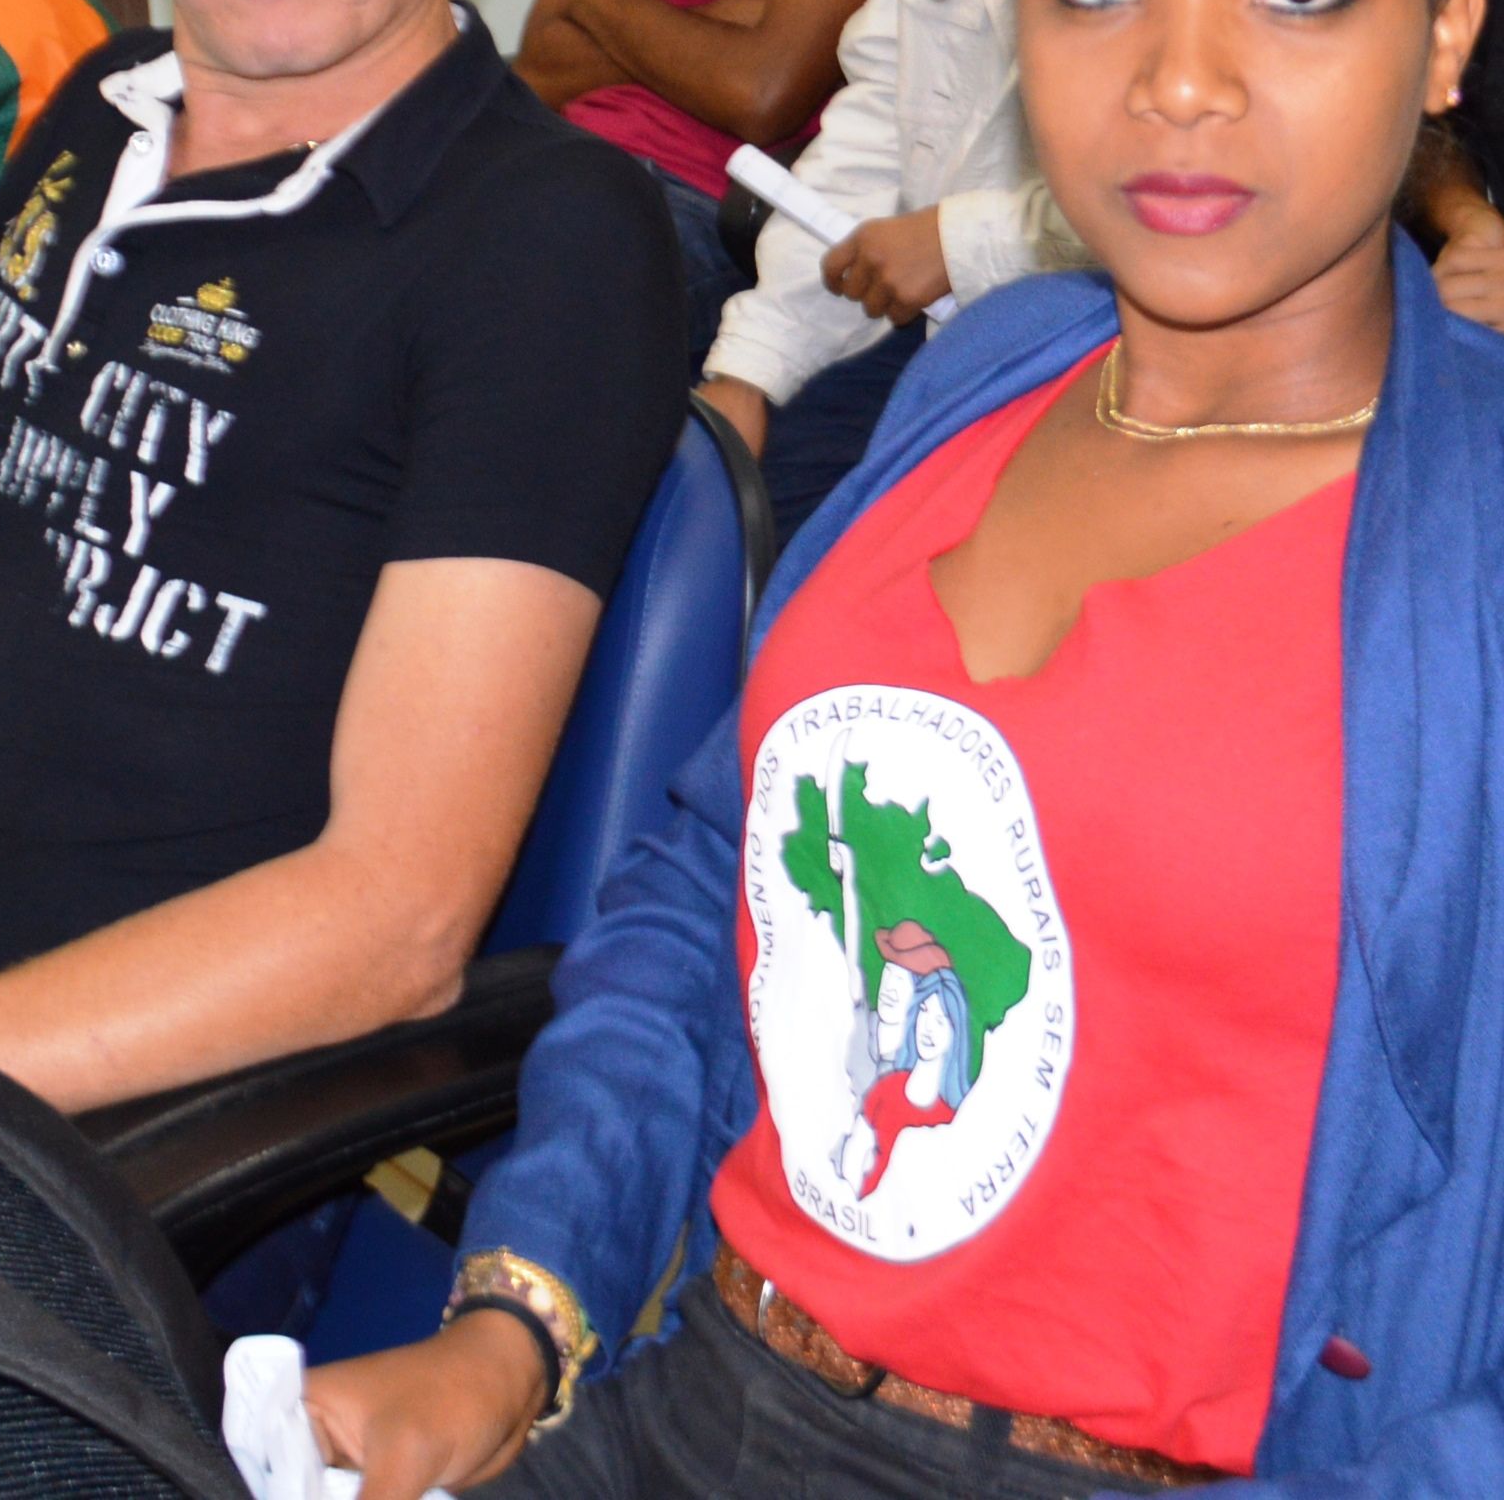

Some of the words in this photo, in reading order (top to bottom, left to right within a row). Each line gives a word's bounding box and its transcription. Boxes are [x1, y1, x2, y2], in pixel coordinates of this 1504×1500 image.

[80, 360, 237, 485] CITY
[754, 747, 780, 815] DOS
[784, 695, 1014, 804] TRABALHADORES
[1004, 816, 1064, 972] RURAIS
[1034, 1002, 1065, 1092] SEM
[794, 1169, 879, 1243] BRASIL
[960, 1111, 1039, 1219] TERRA
